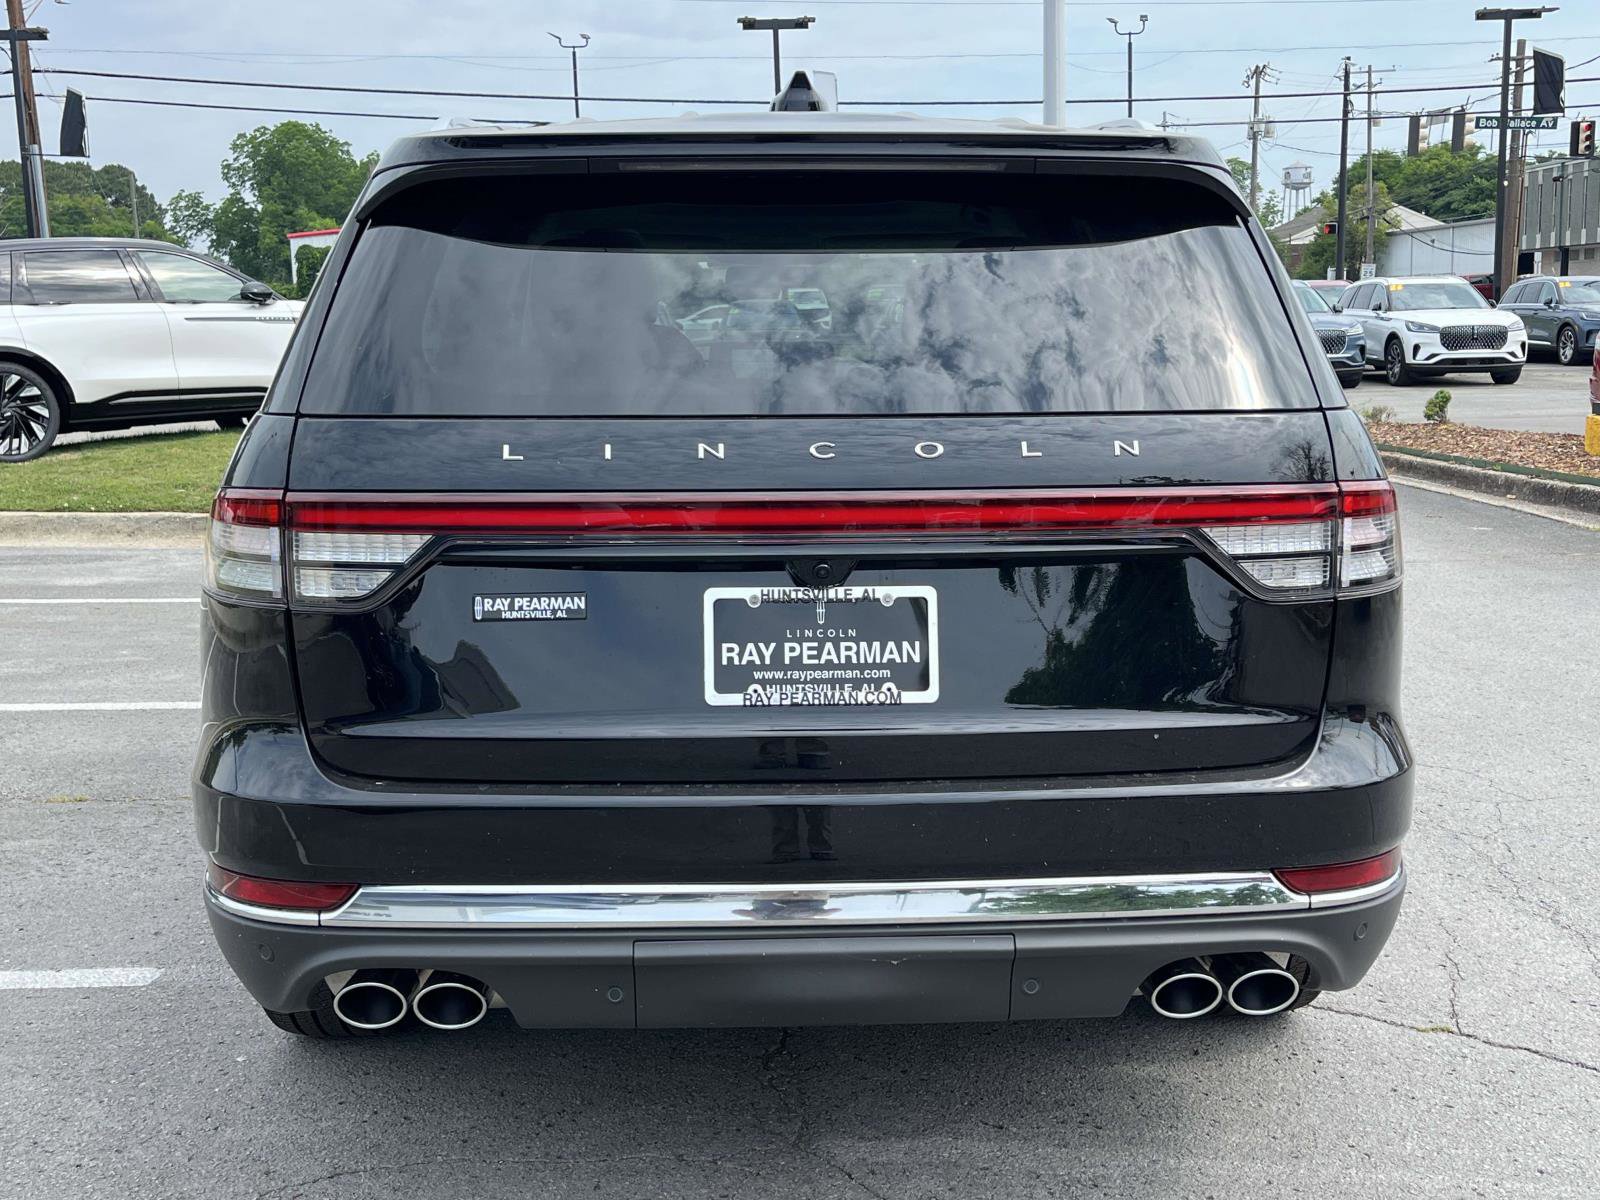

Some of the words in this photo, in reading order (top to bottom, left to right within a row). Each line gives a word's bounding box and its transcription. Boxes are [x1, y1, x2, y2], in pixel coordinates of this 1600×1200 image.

[1479, 118, 1498, 127] Bob
[1507, 118, 1537, 128] allace
[1539, 119, 1554, 128] Av
[502, 439, 1140, 461] LINCOLN
[484, 598, 511, 611] RAY
[514, 596, 586, 610] PEARMAN
[502, 611, 555, 619] HUNTSVILLE,
[556, 610, 568, 618] AL
[786, 628, 857, 638] LINCOLN
[721, 642, 776, 666] RAY
[784, 640, 921, 665] PEARMAN
[753, 669, 891, 682] www.raypearman.com
[743, 691, 774, 707] RAY
